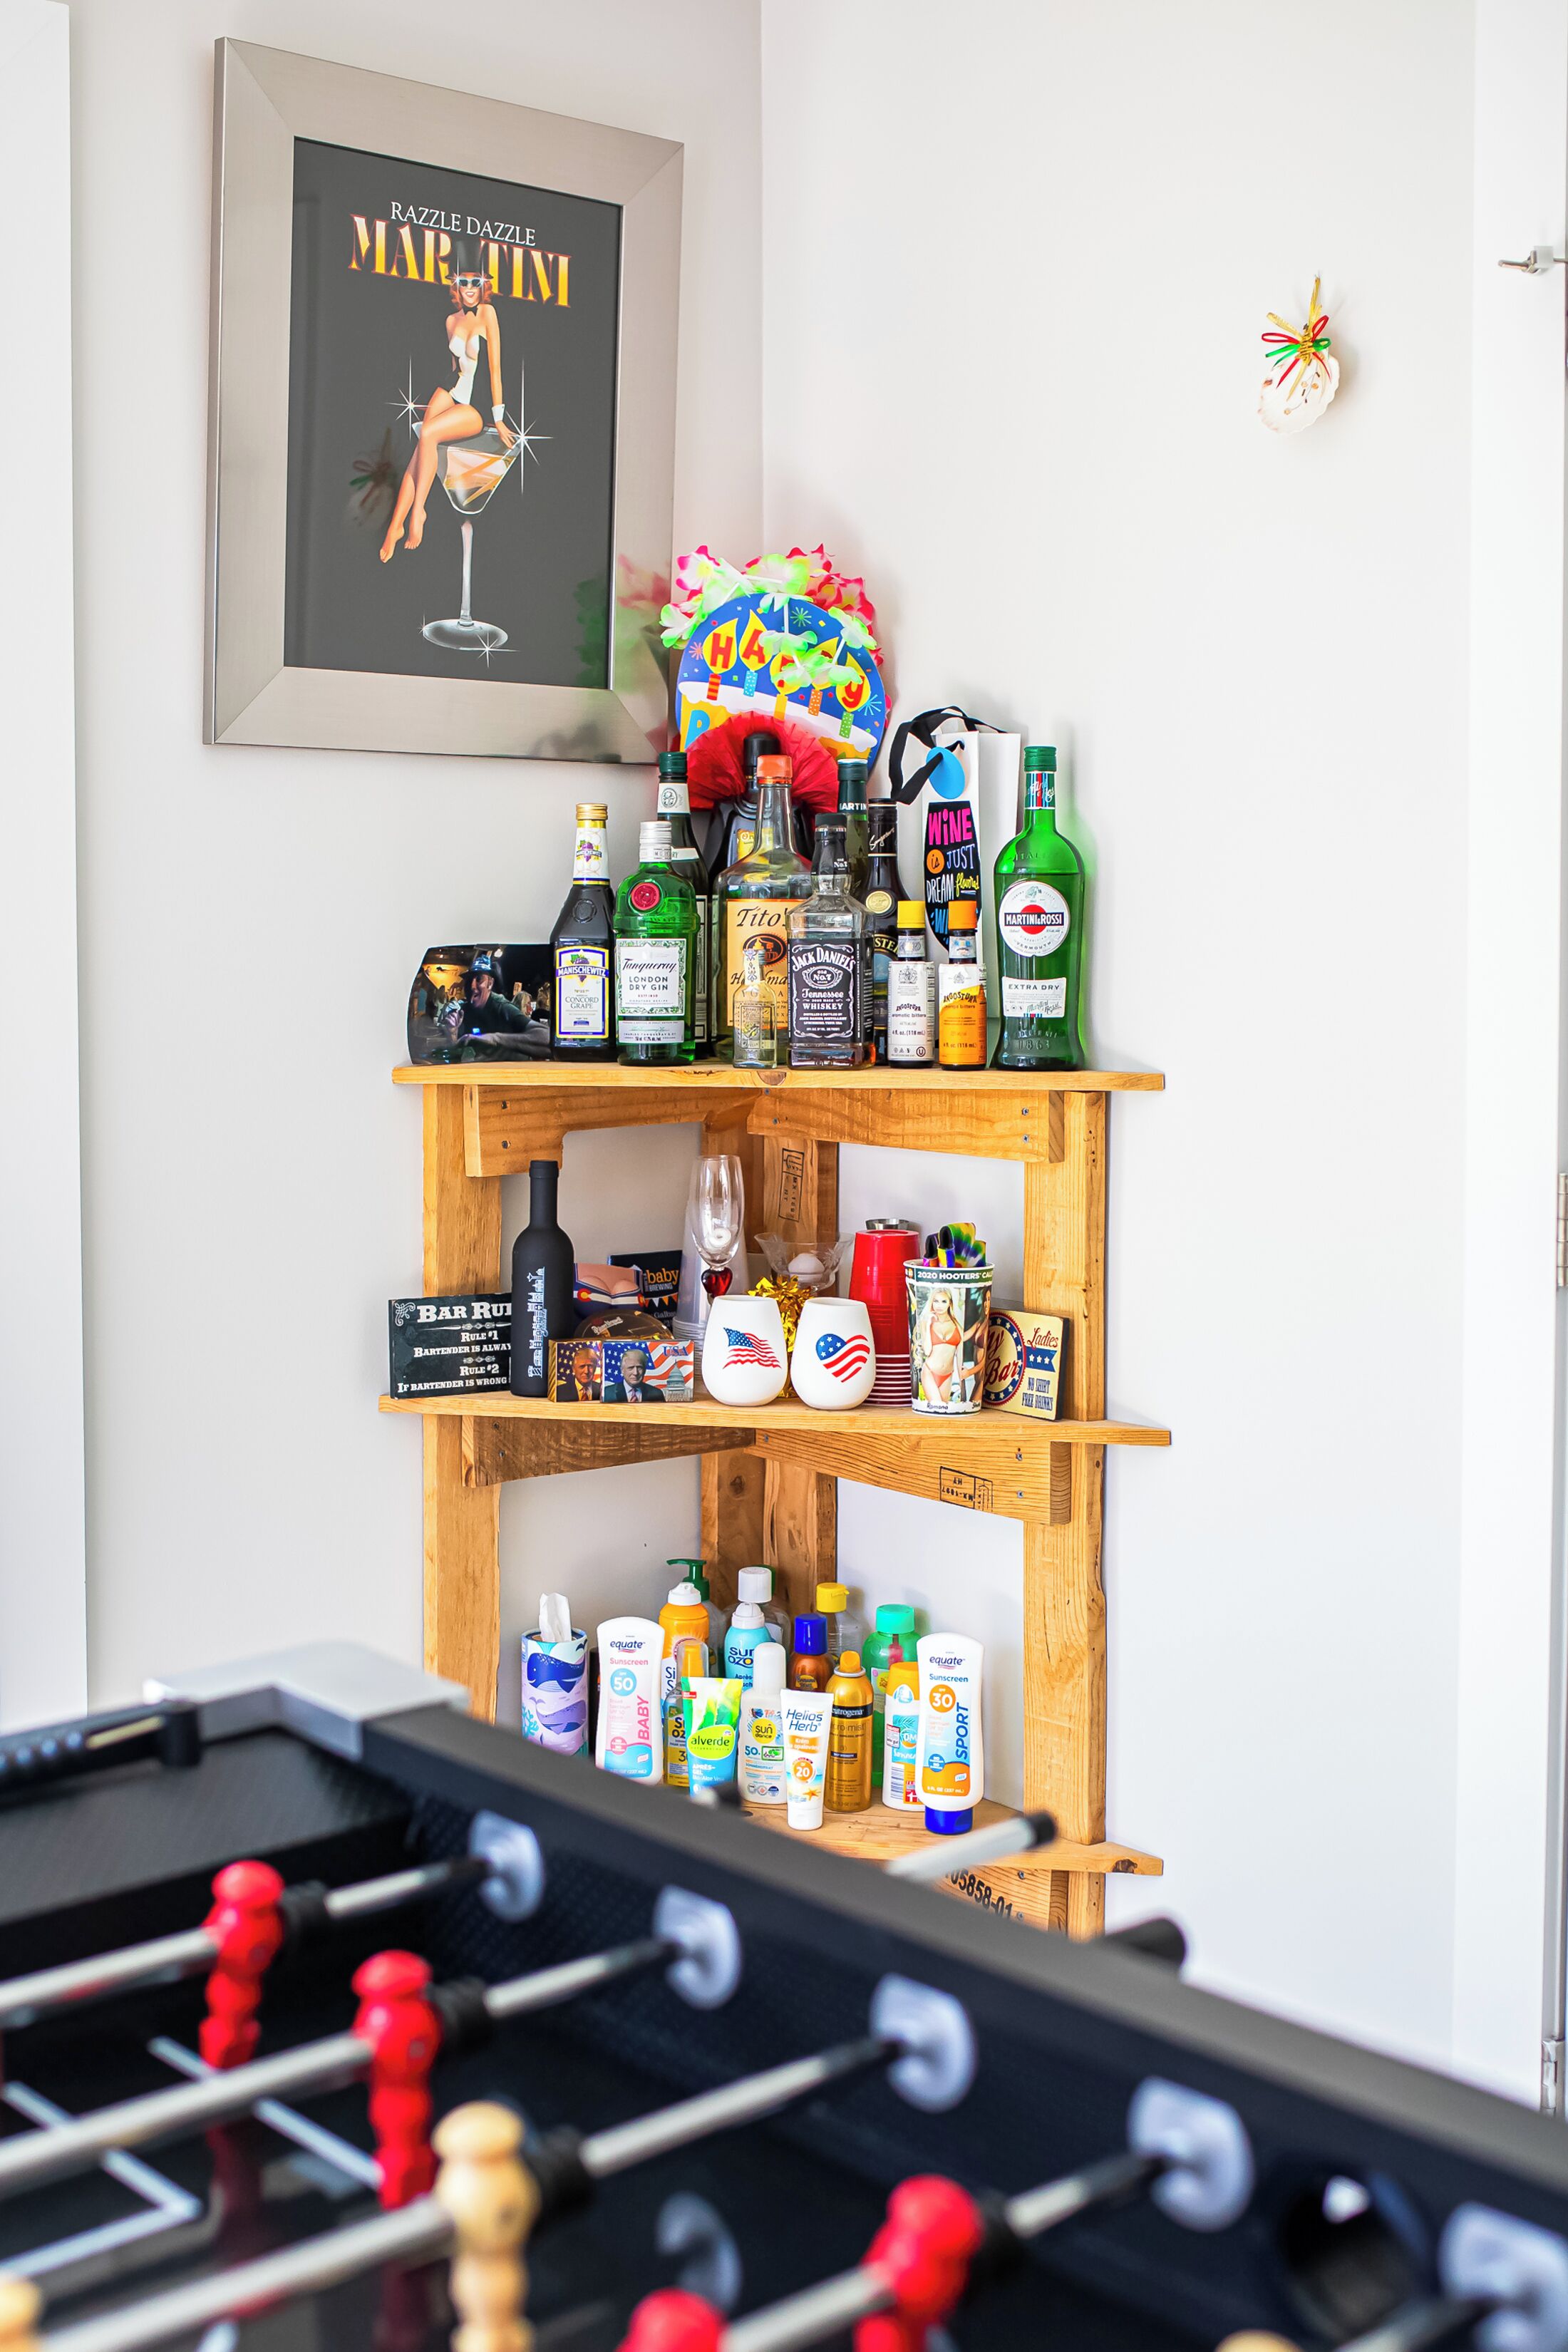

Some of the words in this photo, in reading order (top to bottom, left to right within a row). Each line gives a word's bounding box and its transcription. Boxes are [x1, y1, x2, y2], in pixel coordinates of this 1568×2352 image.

[391, 201, 461, 232] RAZZLE
[467, 216, 535, 247] DAZZLE
[348, 214, 571, 307] MARTINI
[947, 844, 975, 870] JUST
[1016, 942, 1051, 950] VERMOUTH
[622, 958, 676, 973] Tanqueray
[791, 952, 816, 971] JACK
[816, 947, 855, 971] DANIEL'S
[558, 965, 606, 976] MANISCHEWITZ
[802, 988, 844, 998] Tennessee
[646, 1268, 679, 1285] baby
[417, 1304, 468, 1324] BAR
[460, 1332, 486, 1343] RULE
[488, 1330, 499, 1340] #1
[1027, 1327, 1058, 1351] Ladies
[413, 1345, 470, 1358] BARTENDER
[471, 1344, 480, 1353] IS
[662, 1346, 688, 1357] USA
[460, 1366, 485, 1376] RULE
[487, 1363, 499, 1374] #2
[983, 1357, 1018, 1388] Bar
[398, 1382, 410, 1393] IF
[411, 1380, 464, 1392] BARTENDER
[475, 1377, 507, 1386] WRONG
[1027, 1377, 1034, 1391] NO
[1036, 1378, 1051, 1393] SHIRT
[1022, 1393, 1033, 1408] FREE
[1035, 1395, 1053, 1411] DRINKS
[610, 1640, 643, 1650] equate
[929, 1656, 963, 1666] equate
[614, 1676, 634, 1691] 50
[929, 1673, 969, 1682] Sunscreen
[932, 1692, 953, 1708] 30
[637, 1695, 650, 1740] BABY
[786, 1708, 823, 1722] Helios
[789, 1720, 817, 1732] Herb
[955, 1702, 969, 1760] SPORT
[691, 1735, 730, 1746] alverde
[796, 1767, 810, 1778] 20
